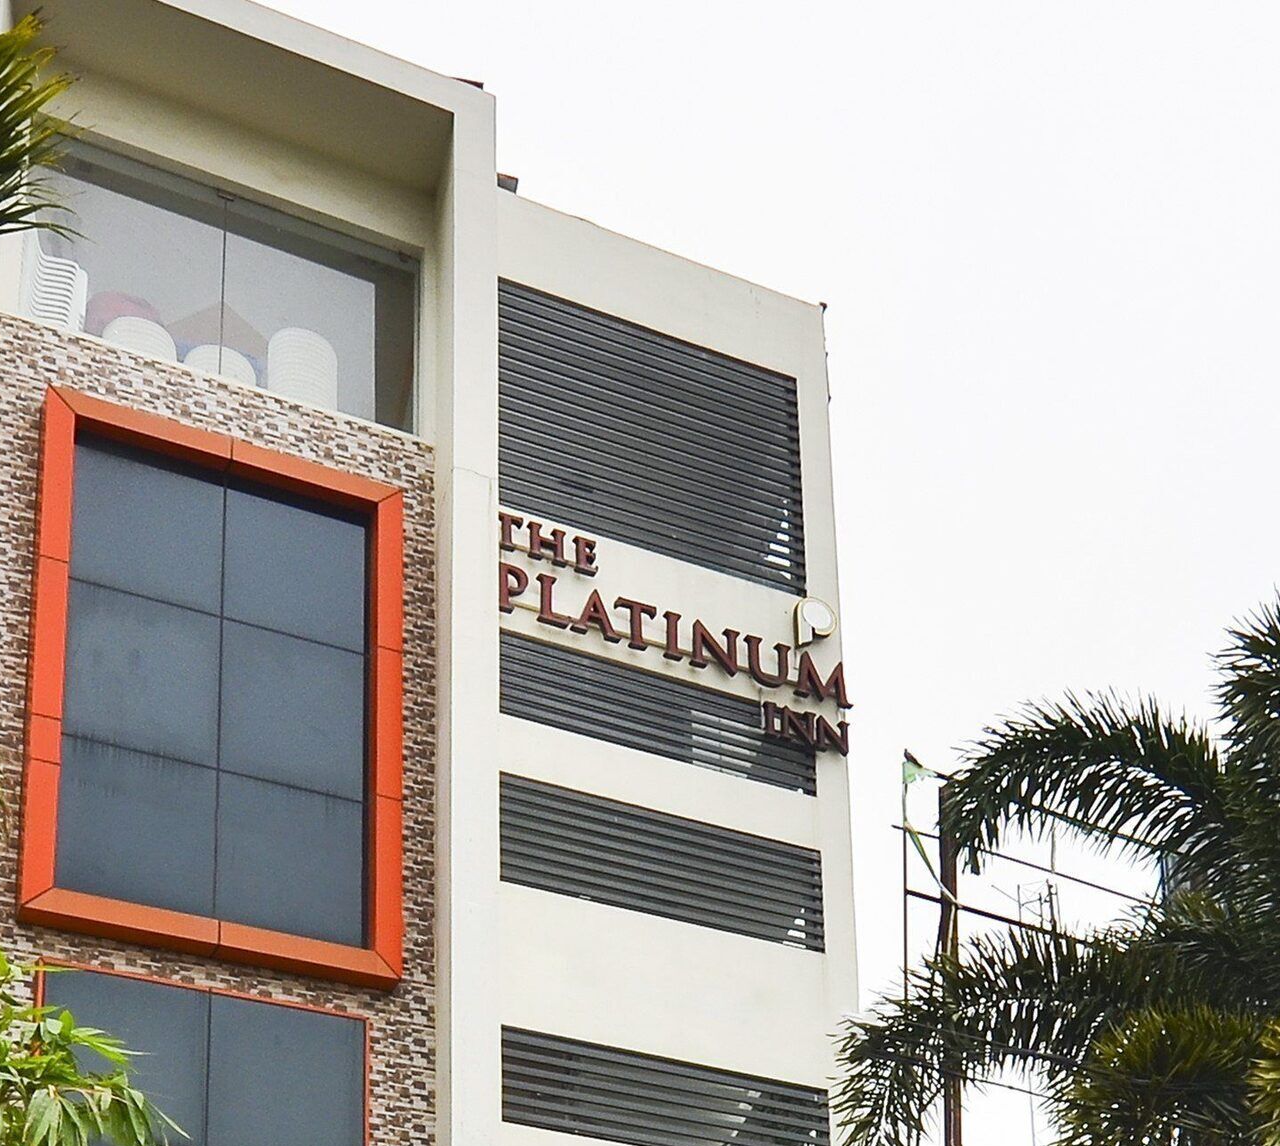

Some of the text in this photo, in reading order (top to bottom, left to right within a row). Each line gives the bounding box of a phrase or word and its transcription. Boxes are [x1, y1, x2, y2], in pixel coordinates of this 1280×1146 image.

[499, 510, 599, 576] THE
[499, 563, 853, 709] PLATINUM
[763, 700, 850, 756] INN
